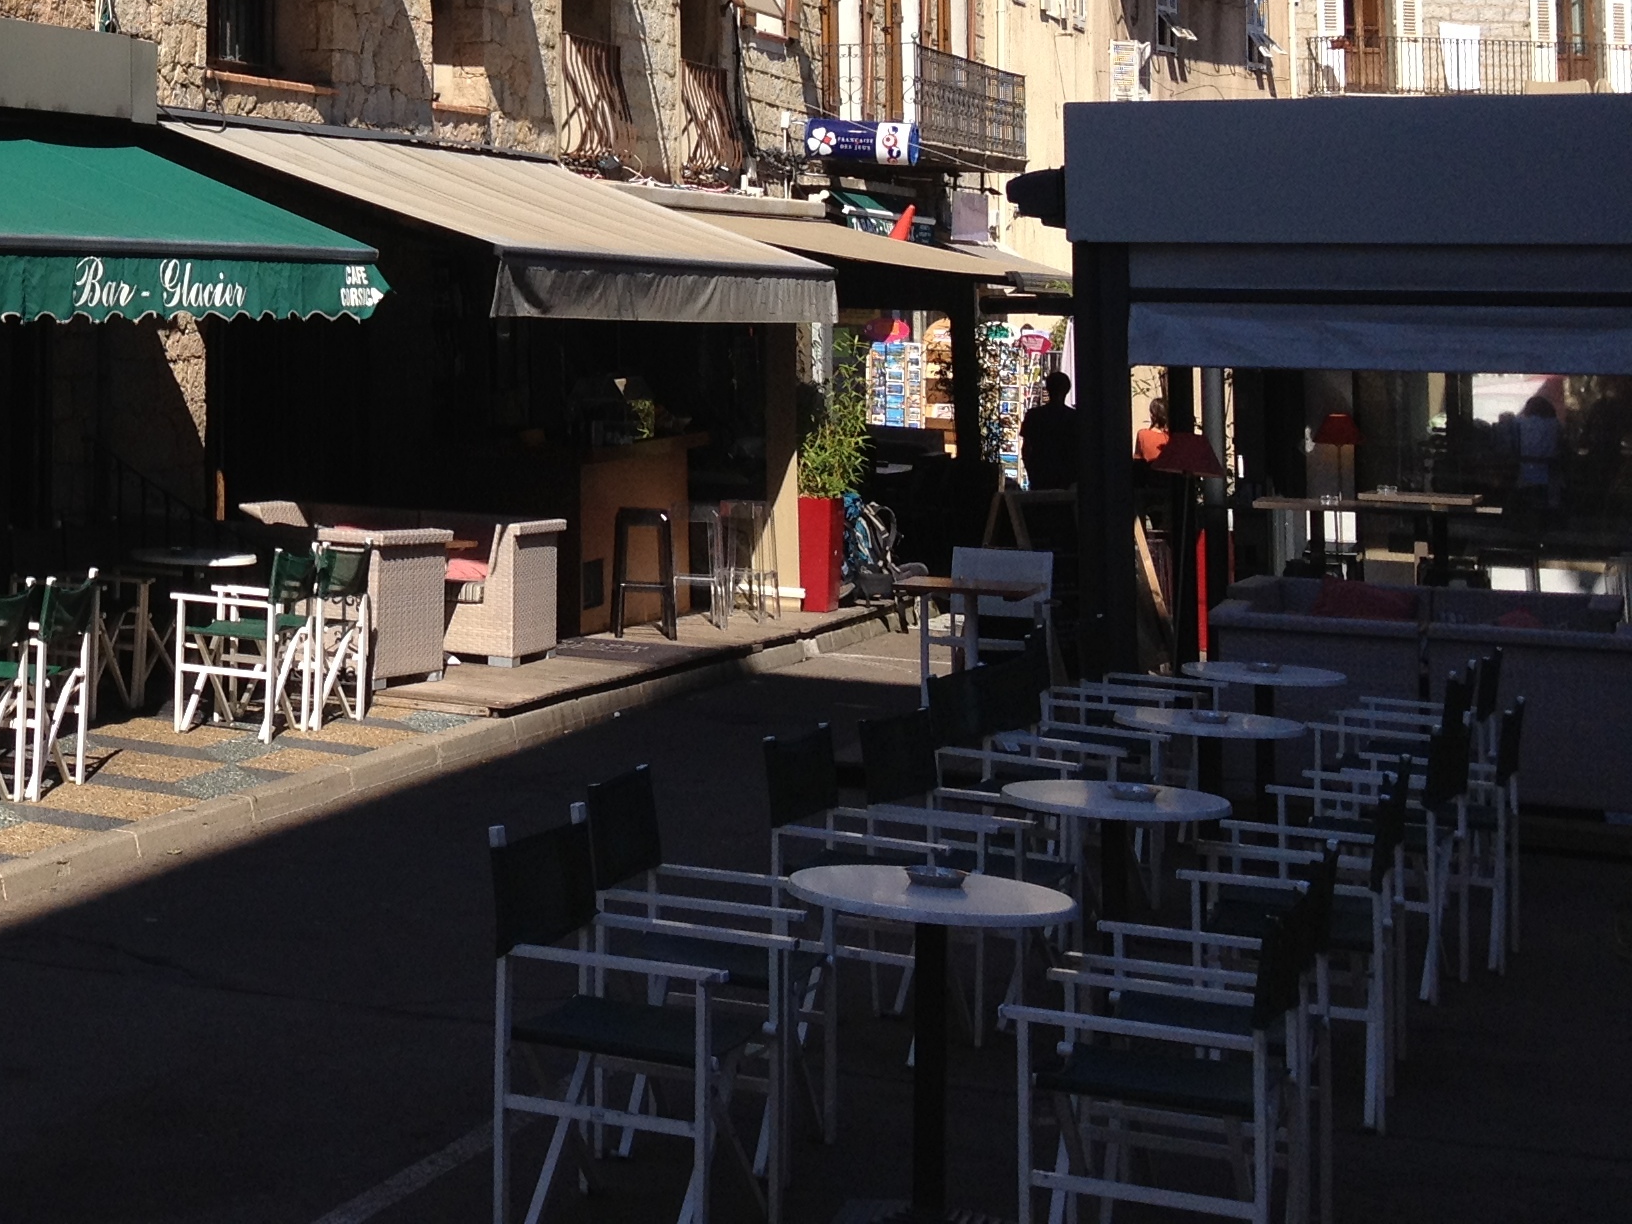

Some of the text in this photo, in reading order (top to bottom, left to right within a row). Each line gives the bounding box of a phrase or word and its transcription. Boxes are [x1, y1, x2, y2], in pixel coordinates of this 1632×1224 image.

[72, 255, 137, 307] Bar
[159, 258, 247, 308] Glacier
[345, 265, 369, 285] CAFE
